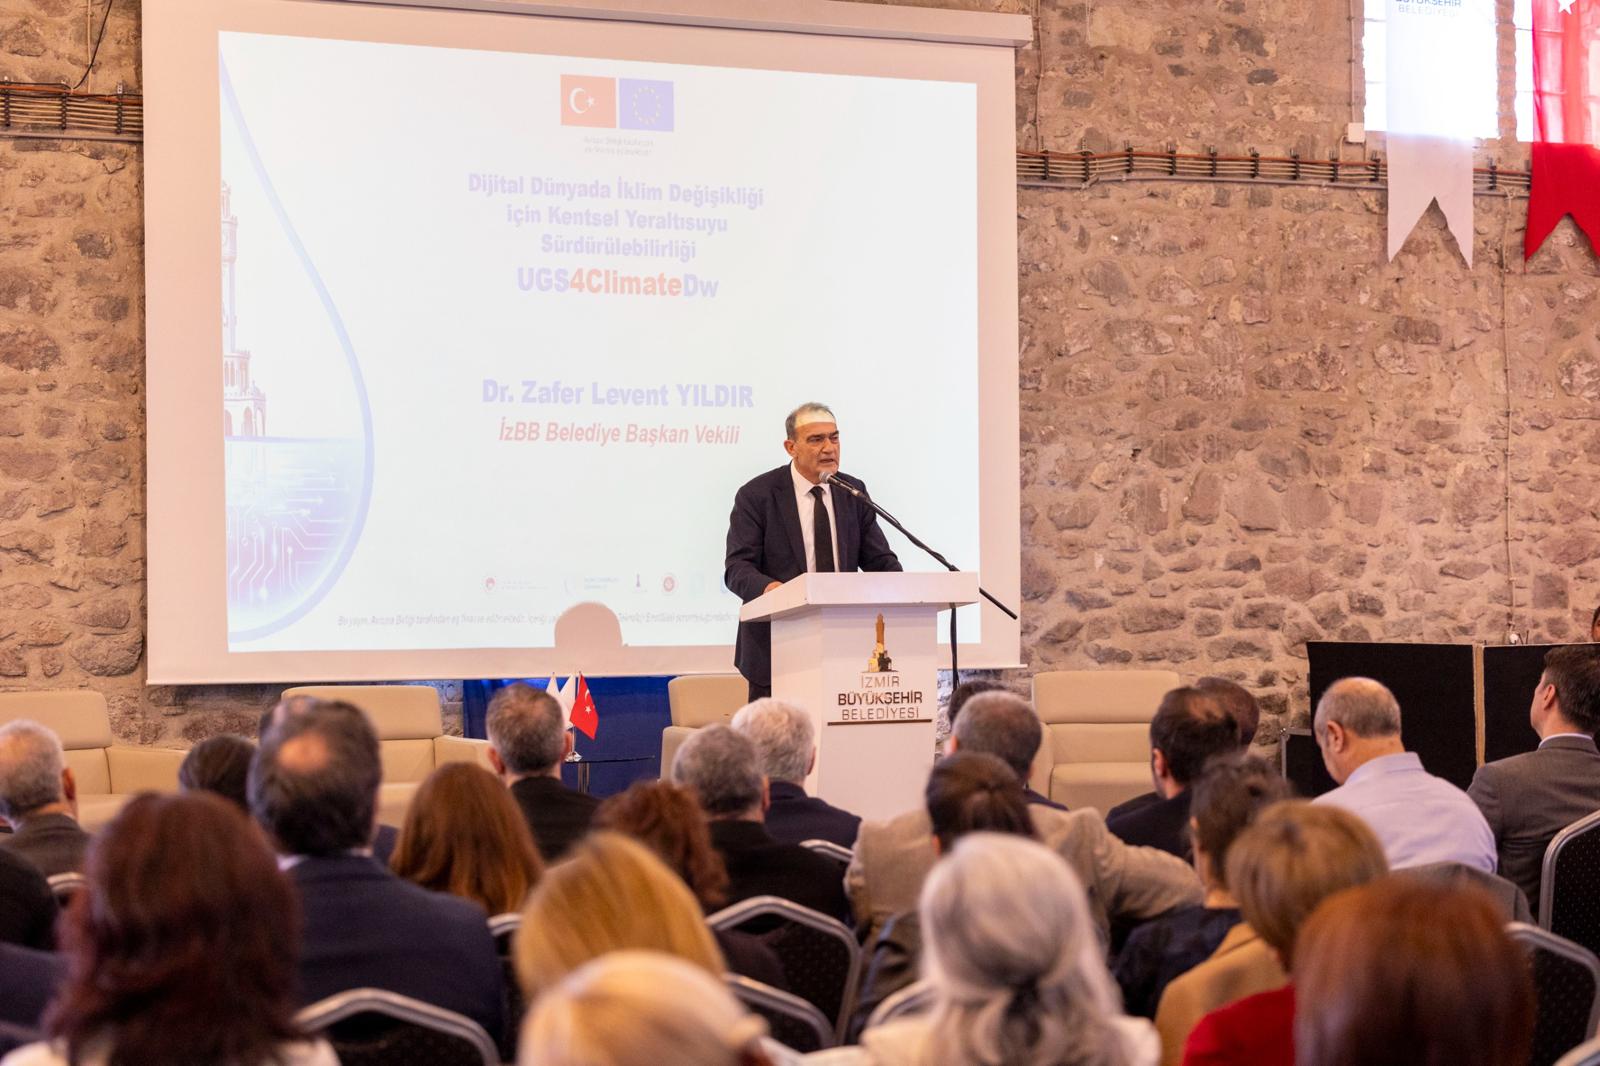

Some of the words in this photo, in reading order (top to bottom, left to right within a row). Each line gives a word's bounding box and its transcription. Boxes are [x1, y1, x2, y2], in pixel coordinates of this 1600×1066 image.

[468, 173, 524, 197] Dijital
[530, 177, 611, 201] Dünyada
[616, 176, 662, 201] İklim
[668, 183, 764, 210] Değişikliği
[507, 204, 541, 227] için
[548, 206, 619, 228] Kentsel
[625, 210, 728, 236] Yeraltısuyu
[541, 233, 696, 262] Sürdürülebilirliği
[517, 267, 719, 298] UGS4ClimateDw
[482, 379, 514, 403] Dr.
[521, 380, 585, 405] Zafer
[592, 382, 669, 406] Levent
[676, 383, 754, 408] YILDIR
[499, 416, 540, 441] İzBB
[545, 421, 620, 447] Belediye
[625, 423, 689, 447] Başkan
[695, 424, 740, 445] Vekili
[861, 675, 900, 689] İZMİR
[838, 690, 923, 706] BÜYÜKŞEHİR
[842, 707, 919, 720] BELEDİYESİ
